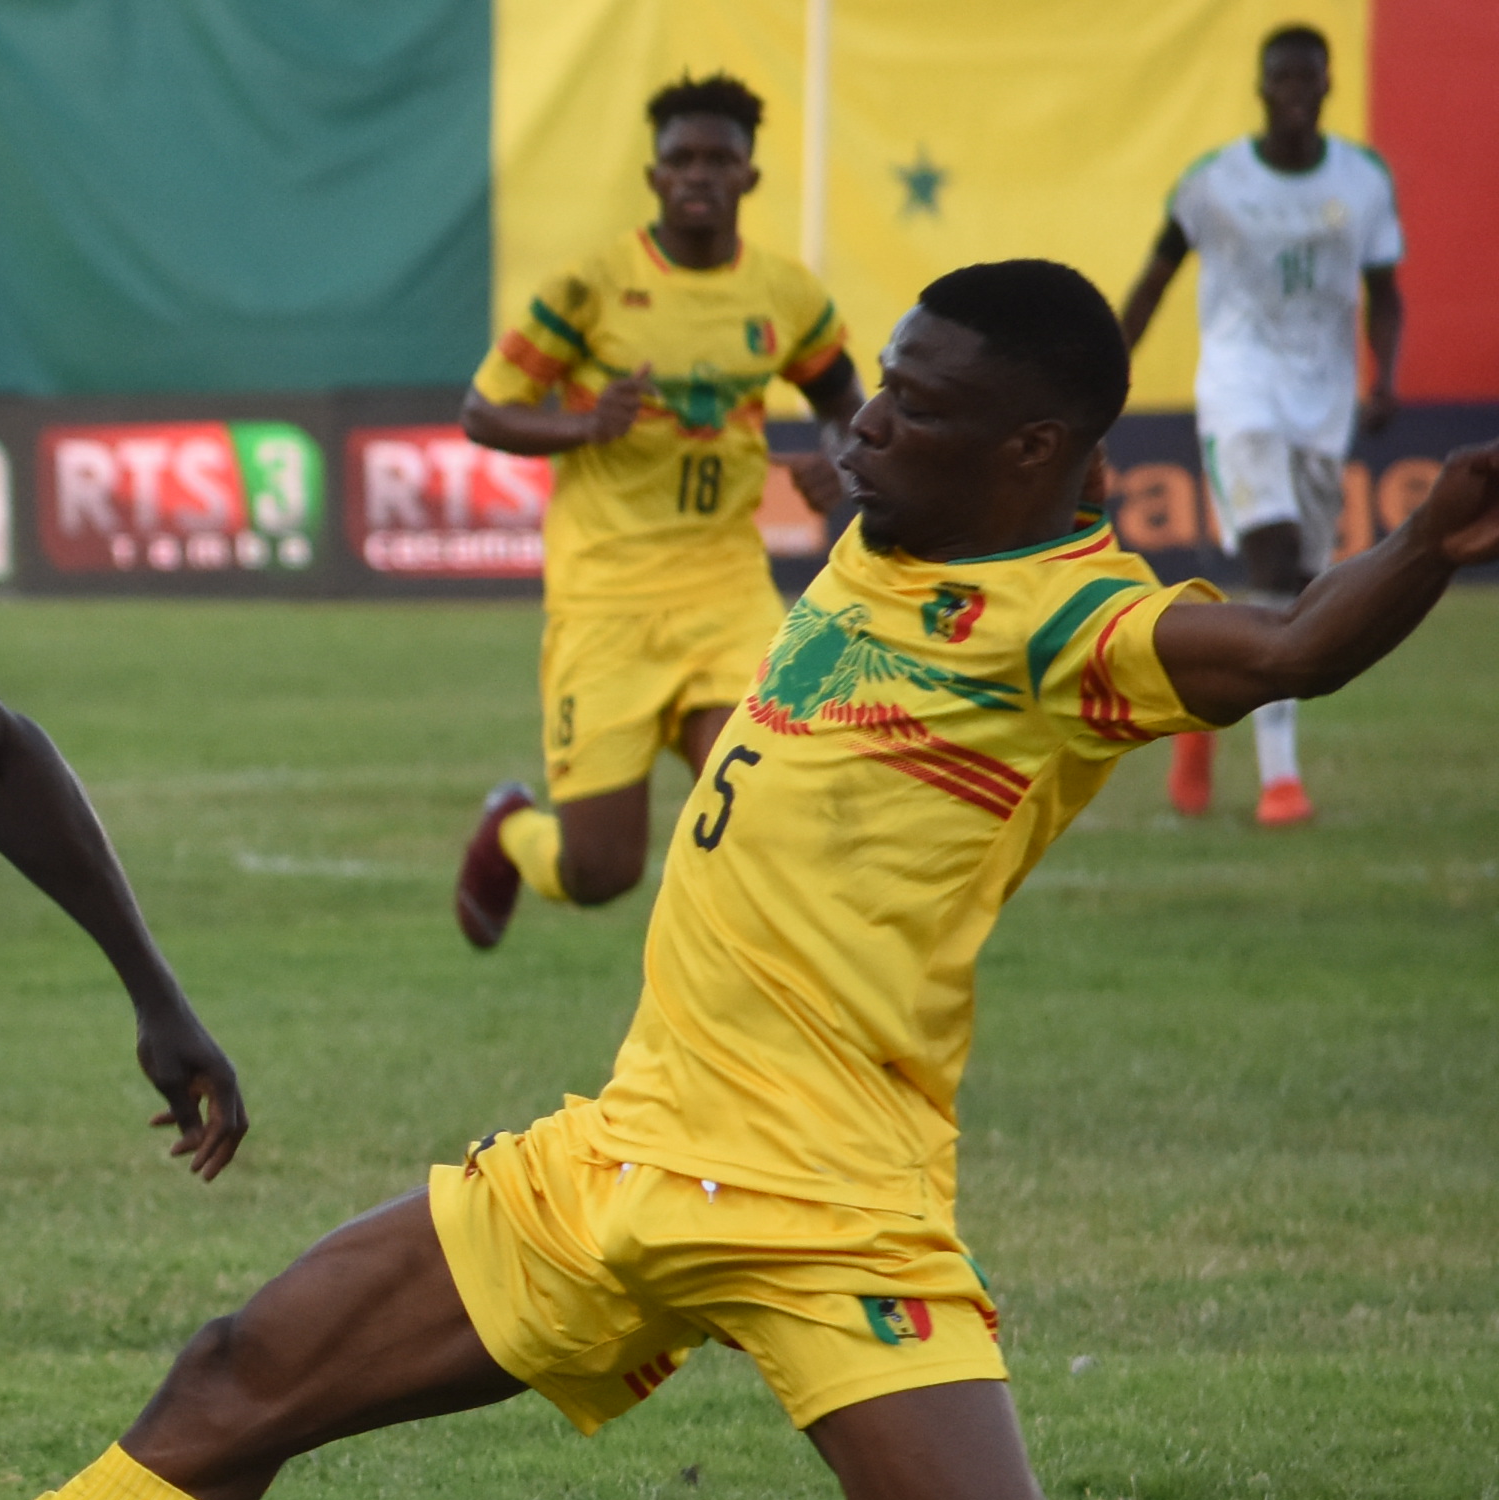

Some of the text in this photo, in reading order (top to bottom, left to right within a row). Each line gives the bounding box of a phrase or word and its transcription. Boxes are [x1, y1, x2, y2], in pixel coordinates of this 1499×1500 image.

[364, 440, 543, 530] RTS
[677, 454, 723, 515] 18
[692, 744, 761, 852] 5
